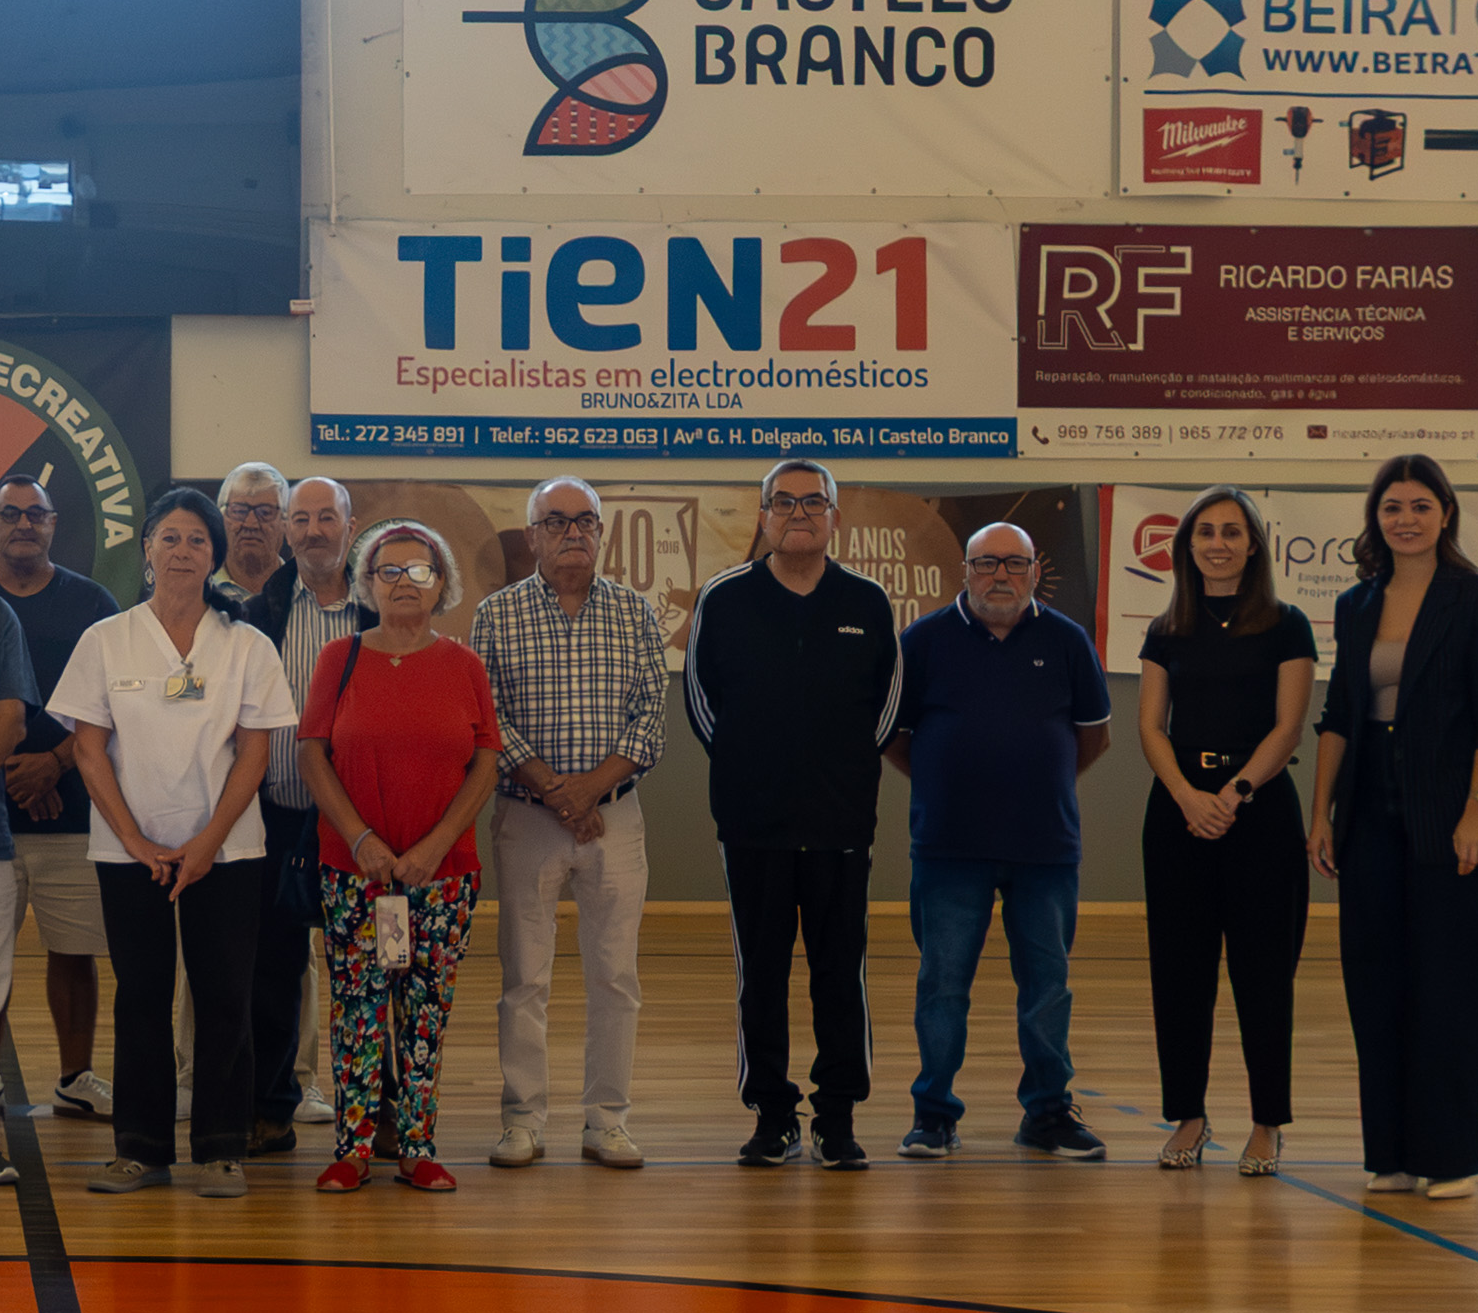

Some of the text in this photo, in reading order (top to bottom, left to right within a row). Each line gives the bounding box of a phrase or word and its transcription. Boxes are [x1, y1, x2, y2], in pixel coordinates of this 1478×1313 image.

[695, 24, 995, 87] BRANCO
[1220, 265, 1454, 289] RICARDO FARIAS
[1037, 244, 1192, 351] RF
[396, 356, 929, 394] Especialistas em electrodomésticos
[581, 392, 743, 409] BRUNO&ZITA LDA
[603, 509, 655, 592] 40
[657, 540, 679, 554] 2016
[848, 527, 906, 560] ANOS
[914, 565, 941, 598] DO
[838, 626, 864, 634] adidas
